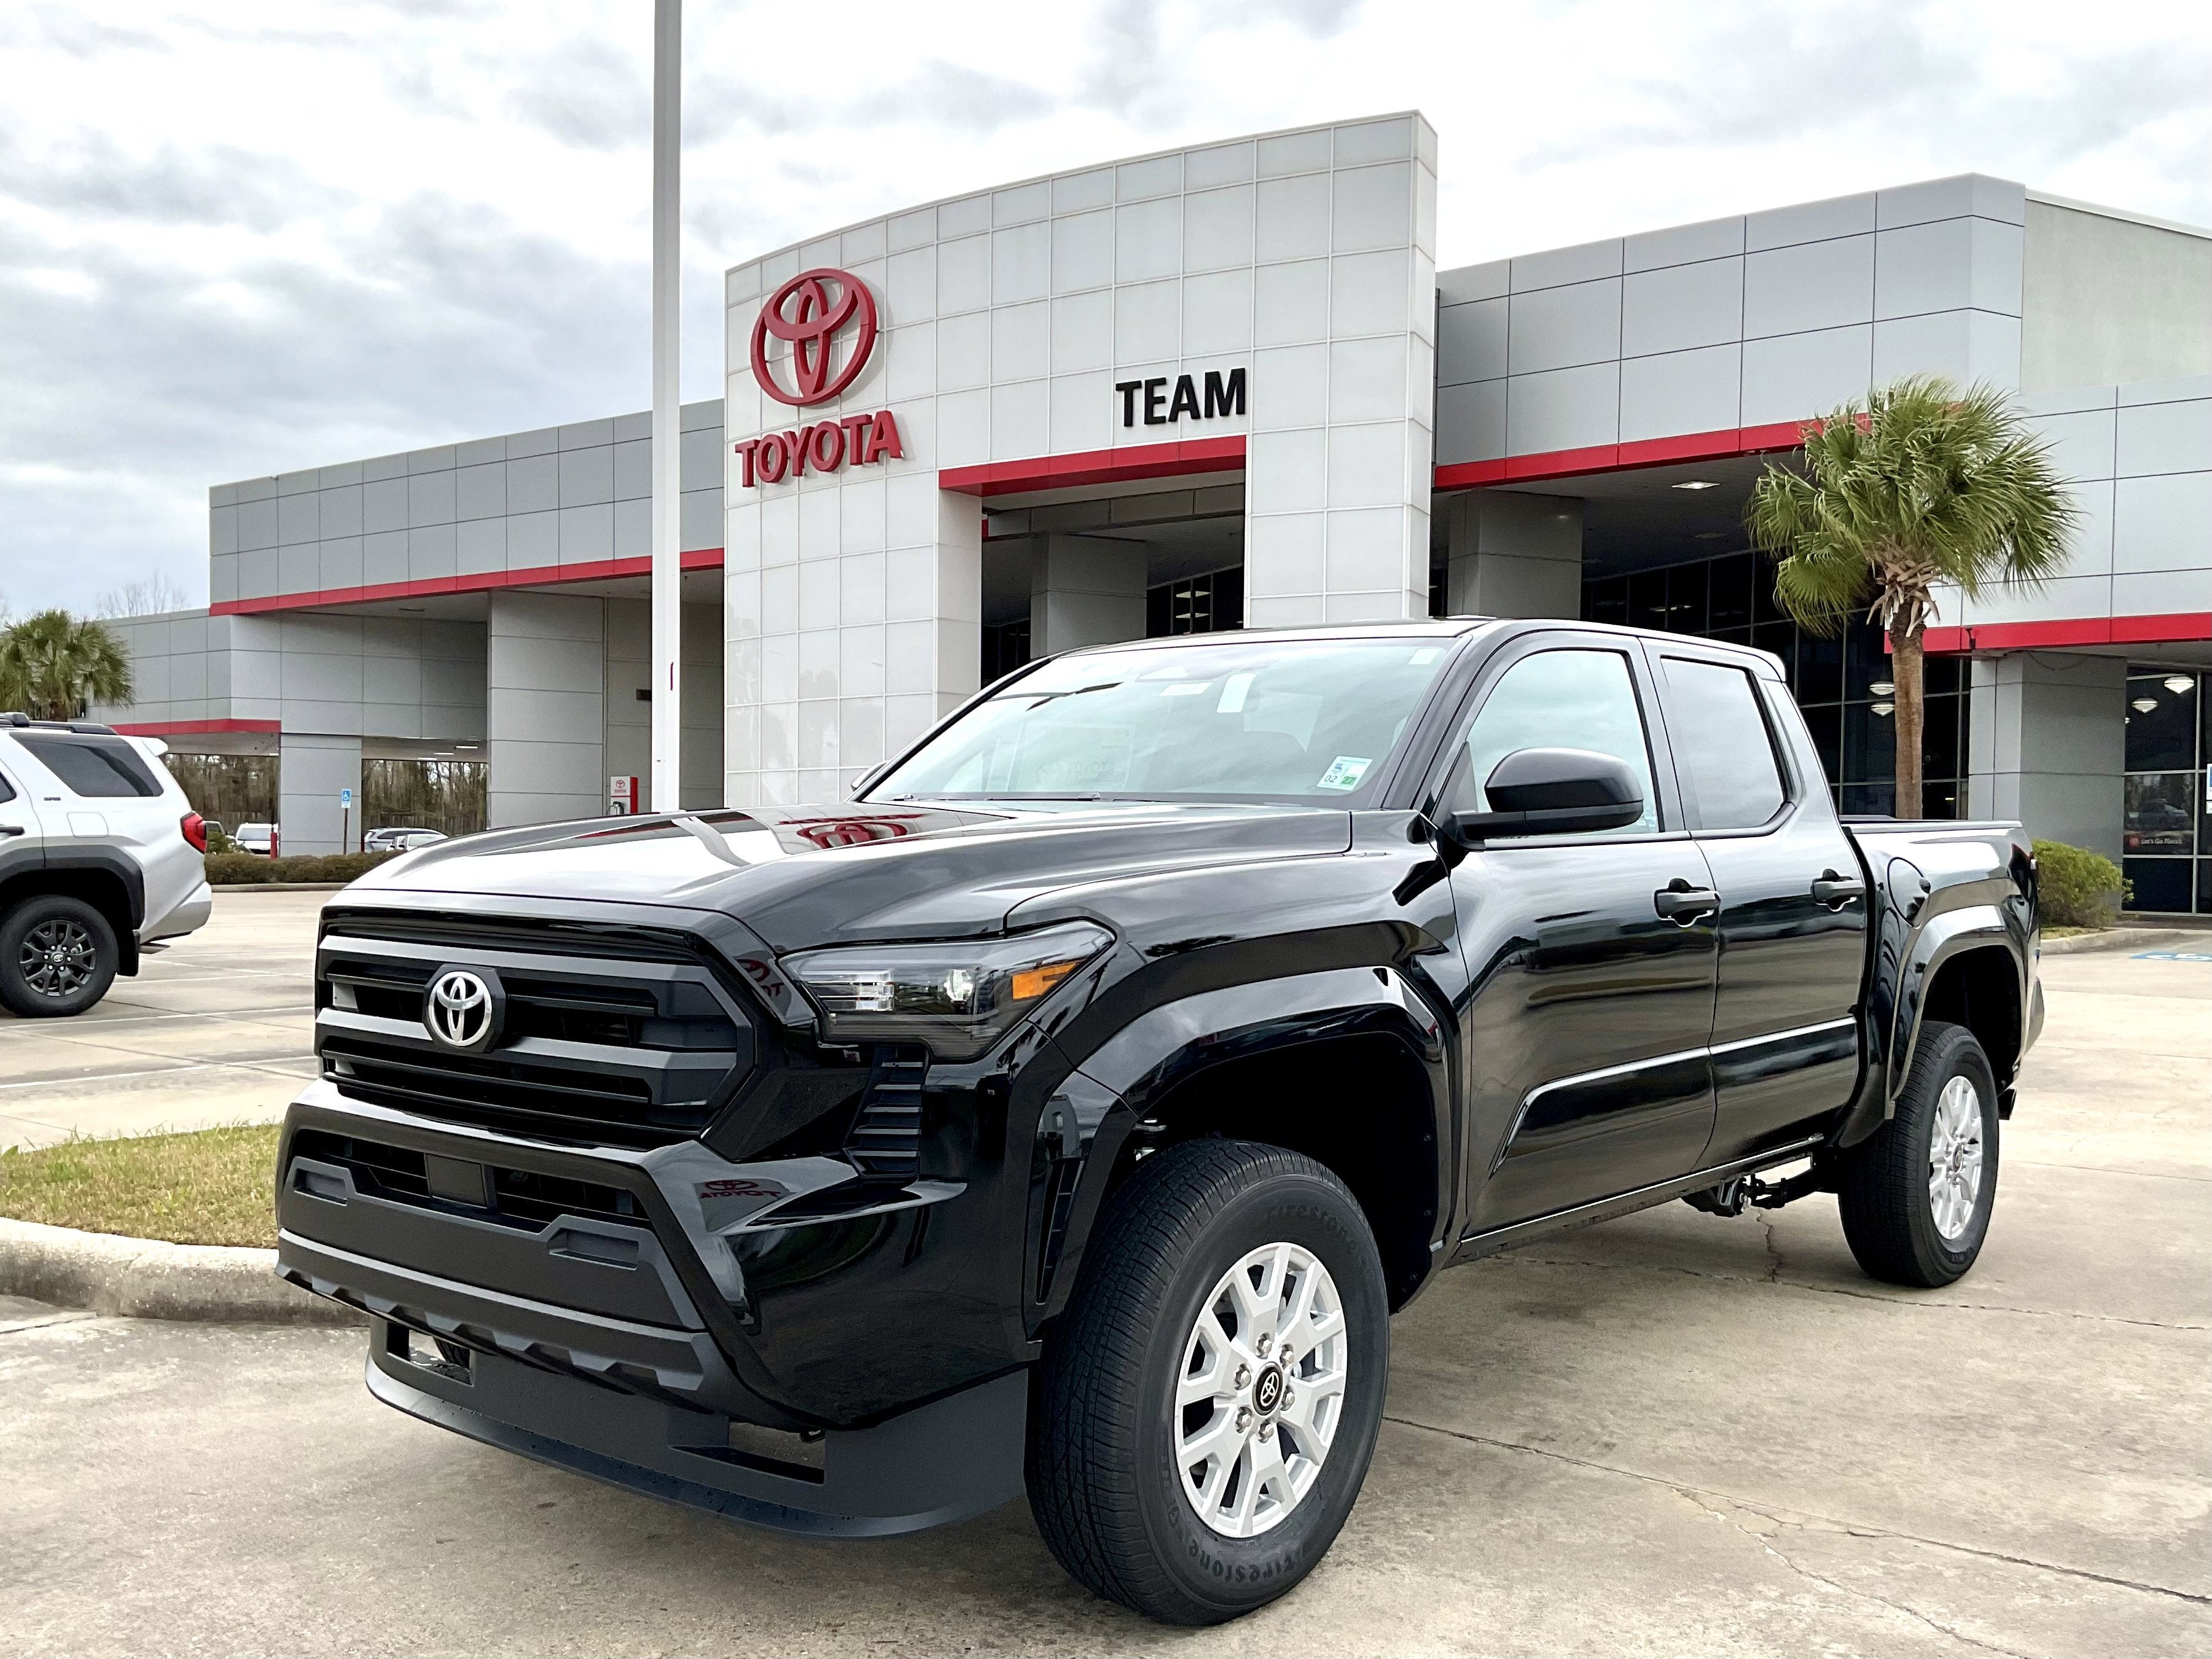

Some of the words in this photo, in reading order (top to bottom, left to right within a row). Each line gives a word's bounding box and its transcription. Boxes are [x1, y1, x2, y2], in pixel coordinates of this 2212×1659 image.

[1116, 367, 1246, 427] TEAM
[735, 410, 904, 487] TOYOTA
[1324, 775, 1338, 783] 02
[1341, 776, 1358, 784] 27
[1189, 1539, 1296, 1583] Firestone
